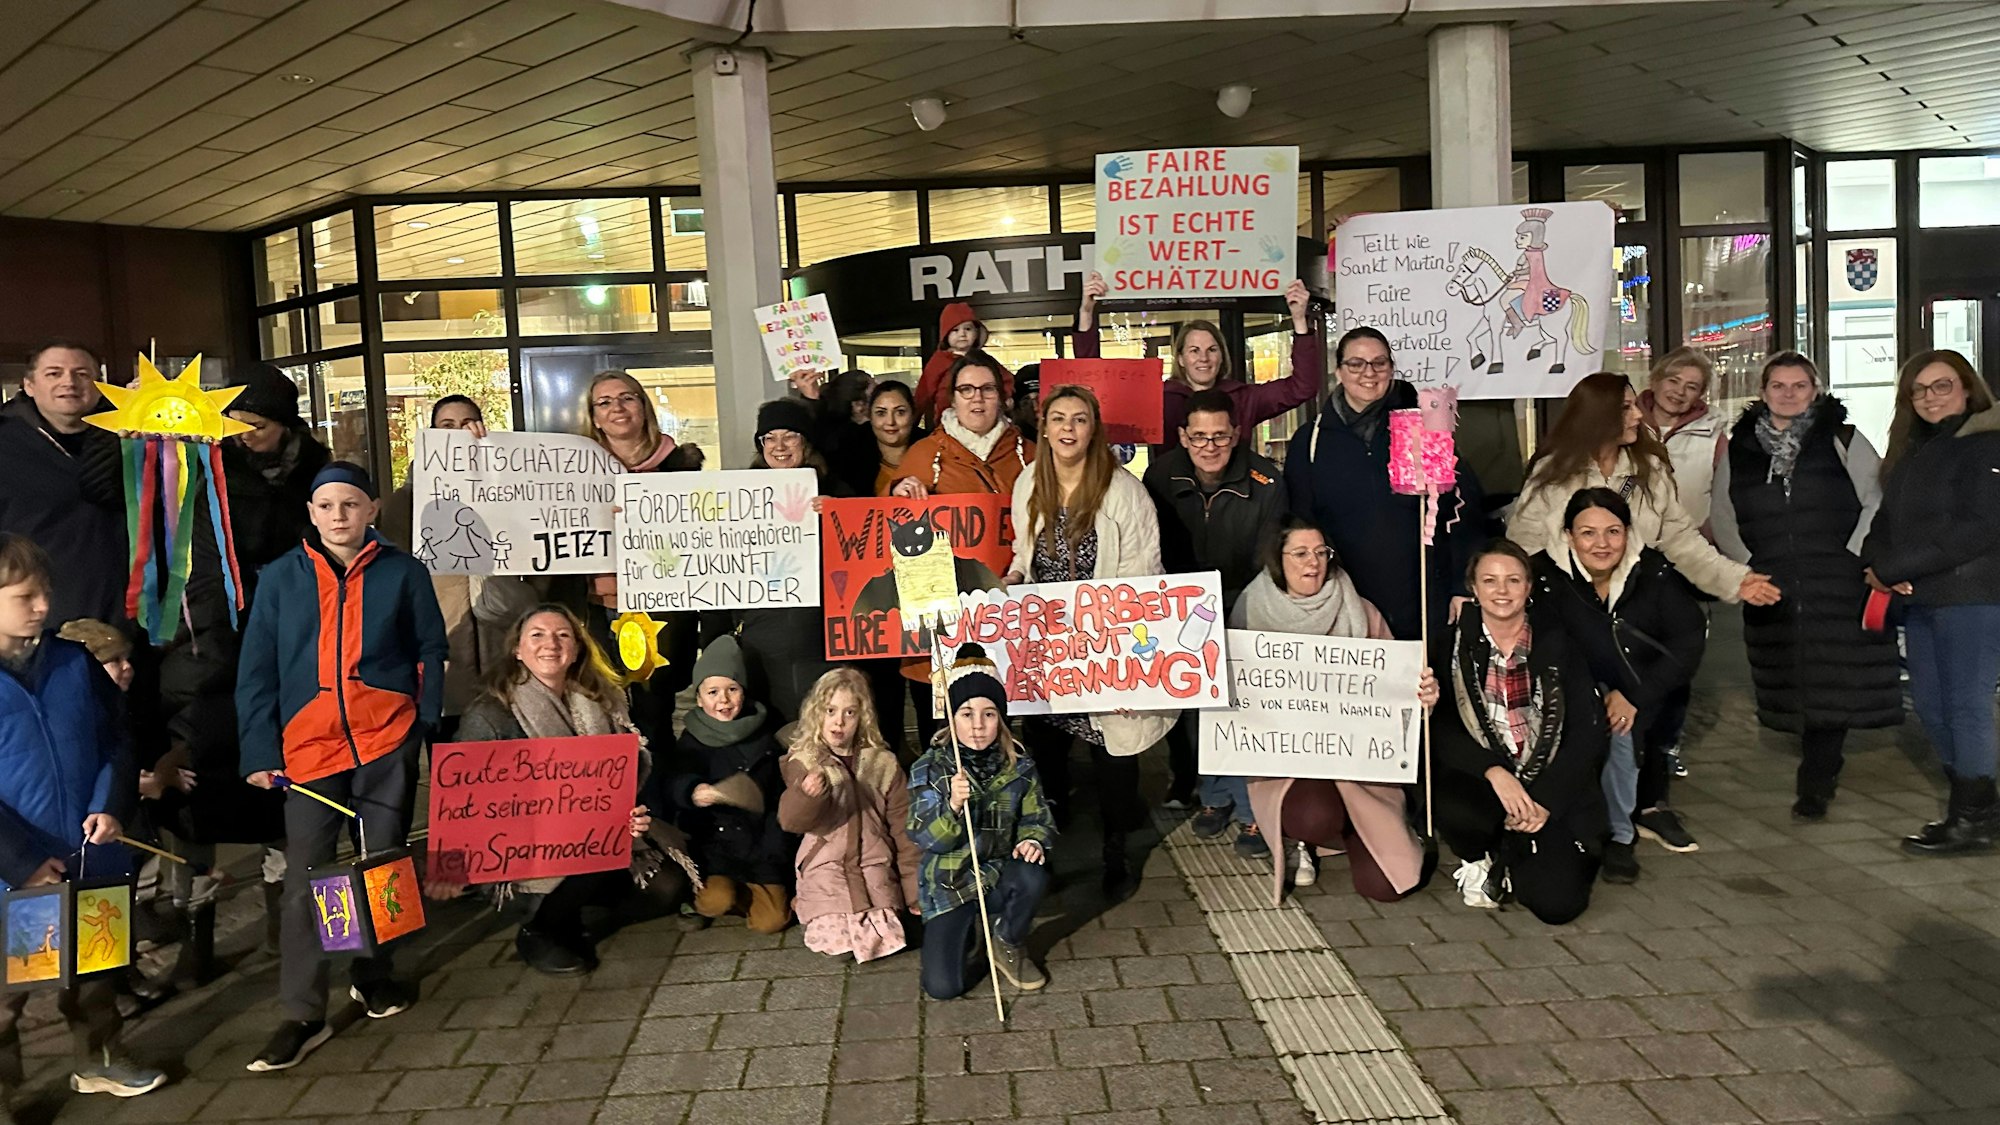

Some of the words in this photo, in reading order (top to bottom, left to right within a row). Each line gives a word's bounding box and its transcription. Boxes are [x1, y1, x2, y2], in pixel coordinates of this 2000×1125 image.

[1147, 150, 1226, 173] FAIRE
[1108, 174, 1270, 201] BEZAHLUNG
[1120, 214, 1159, 235] IST
[1173, 210, 1255, 233] ECHTE
[1149, 240, 1241, 261] WERT-
[1353, 233, 1399, 253] Teilt
[1406, 235, 1431, 249] wie
[1114, 265, 1280, 290] SCHÄTZUNG
[1340, 254, 1389, 277] Sankt
[1367, 284, 1411, 304] Faire
[772, 300, 808, 315] FAIRE
[1342, 307, 1448, 335] Bezahlung
[776, 341, 823, 357] UNSERE
[1389, 333, 1453, 352] ertvolle
[422, 432, 621, 475] WERTSCHÄTZUNG
[464, 479, 575, 503] TAGESMÜTTER
[582, 483, 616, 503] UND
[623, 483, 774, 524] FÖRDERGELDER
[532, 530, 612, 572] JETZT
[623, 528, 664, 550] dahin
[671, 534, 688, 549] wo
[692, 527, 713, 549] sie
[623, 558, 648, 586] für
[653, 556, 677, 579] die
[680, 551, 775, 577] ZUKUNFT
[626, 589, 685, 610] unserer
[687, 577, 802, 607] KINDER
[827, 614, 888, 657] EURE
[1255, 633, 1304, 661] GEBT
[1315, 645, 1386, 670] MEINER
[1260, 699, 1282, 710] VON
[1288, 699, 1329, 713] EUREM
[1340, 702, 1392, 718] WARMEN
[1214, 720, 1353, 757] MÄNTELCHEN
[438, 750, 508, 788] Gute
[513, 748, 628, 789] Betreuung
[438, 792, 480, 822] hat
[485, 793, 553, 819] seinen
[559, 784, 612, 814] Preis
[483, 825, 626, 875] Sparmodell
